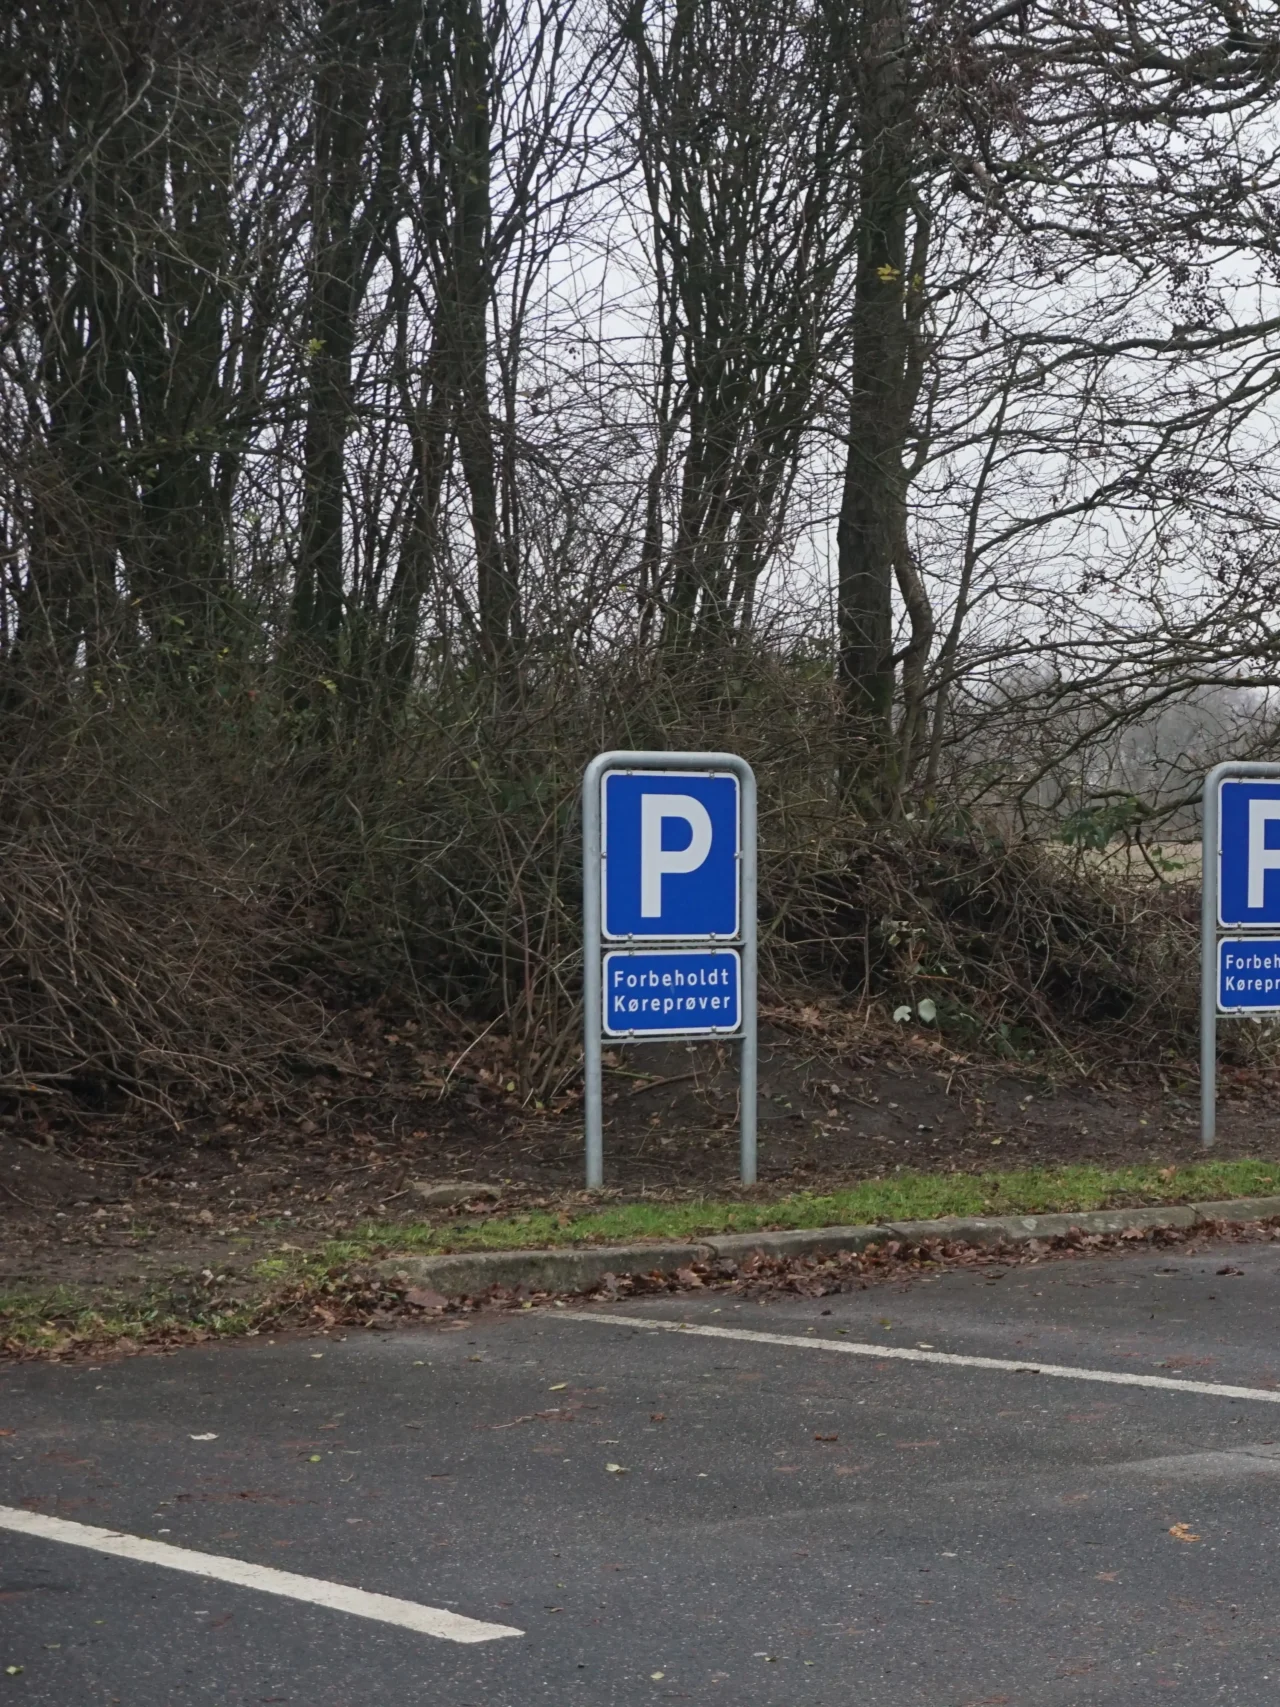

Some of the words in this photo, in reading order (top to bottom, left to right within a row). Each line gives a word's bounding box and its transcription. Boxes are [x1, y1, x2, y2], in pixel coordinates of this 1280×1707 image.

[641, 794, 713, 918] P
[614, 968, 729, 988] Forbeholdt
[614, 995, 731, 1015] Køreprøver
